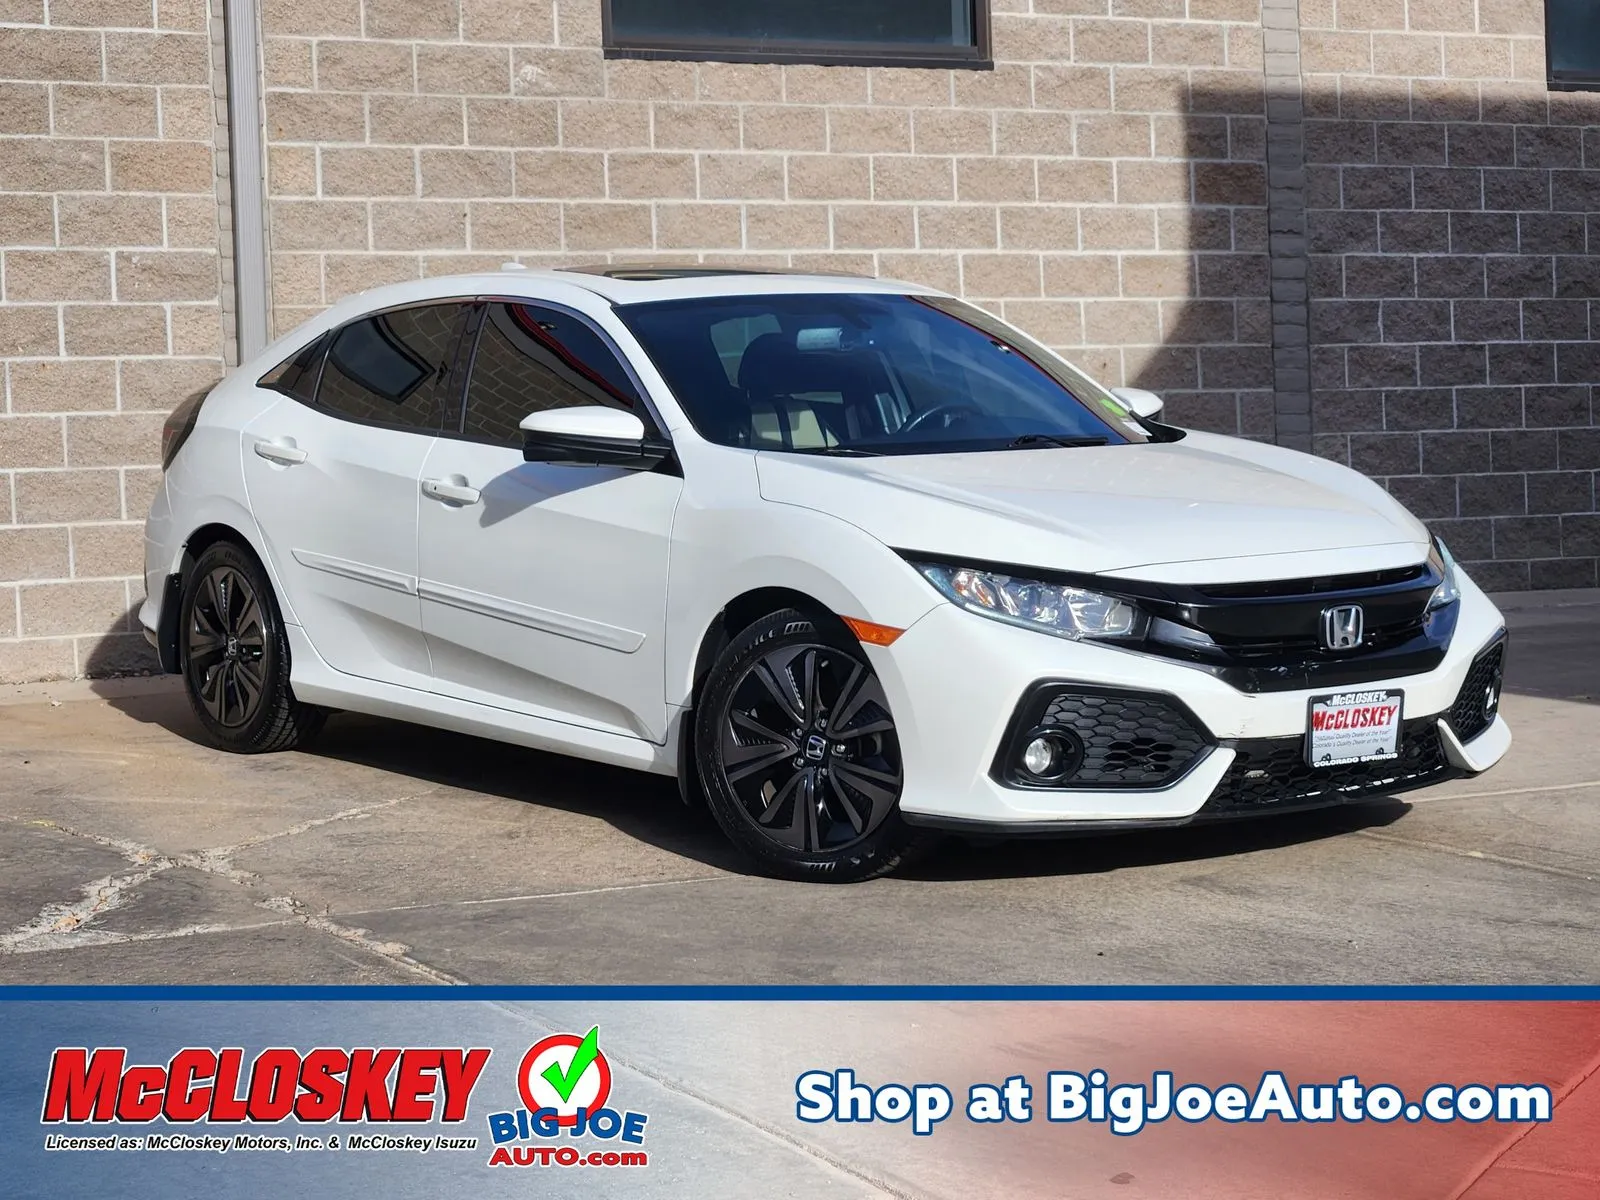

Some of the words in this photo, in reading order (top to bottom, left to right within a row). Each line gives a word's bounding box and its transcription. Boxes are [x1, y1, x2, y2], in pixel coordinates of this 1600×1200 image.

[1332, 691, 1387, 706] McCLOSKEY
[1313, 705, 1398, 730] McCLOSKEY
[1313, 756, 1359, 767] COLORADO
[1360, 752, 1398, 762] SPRINGS
